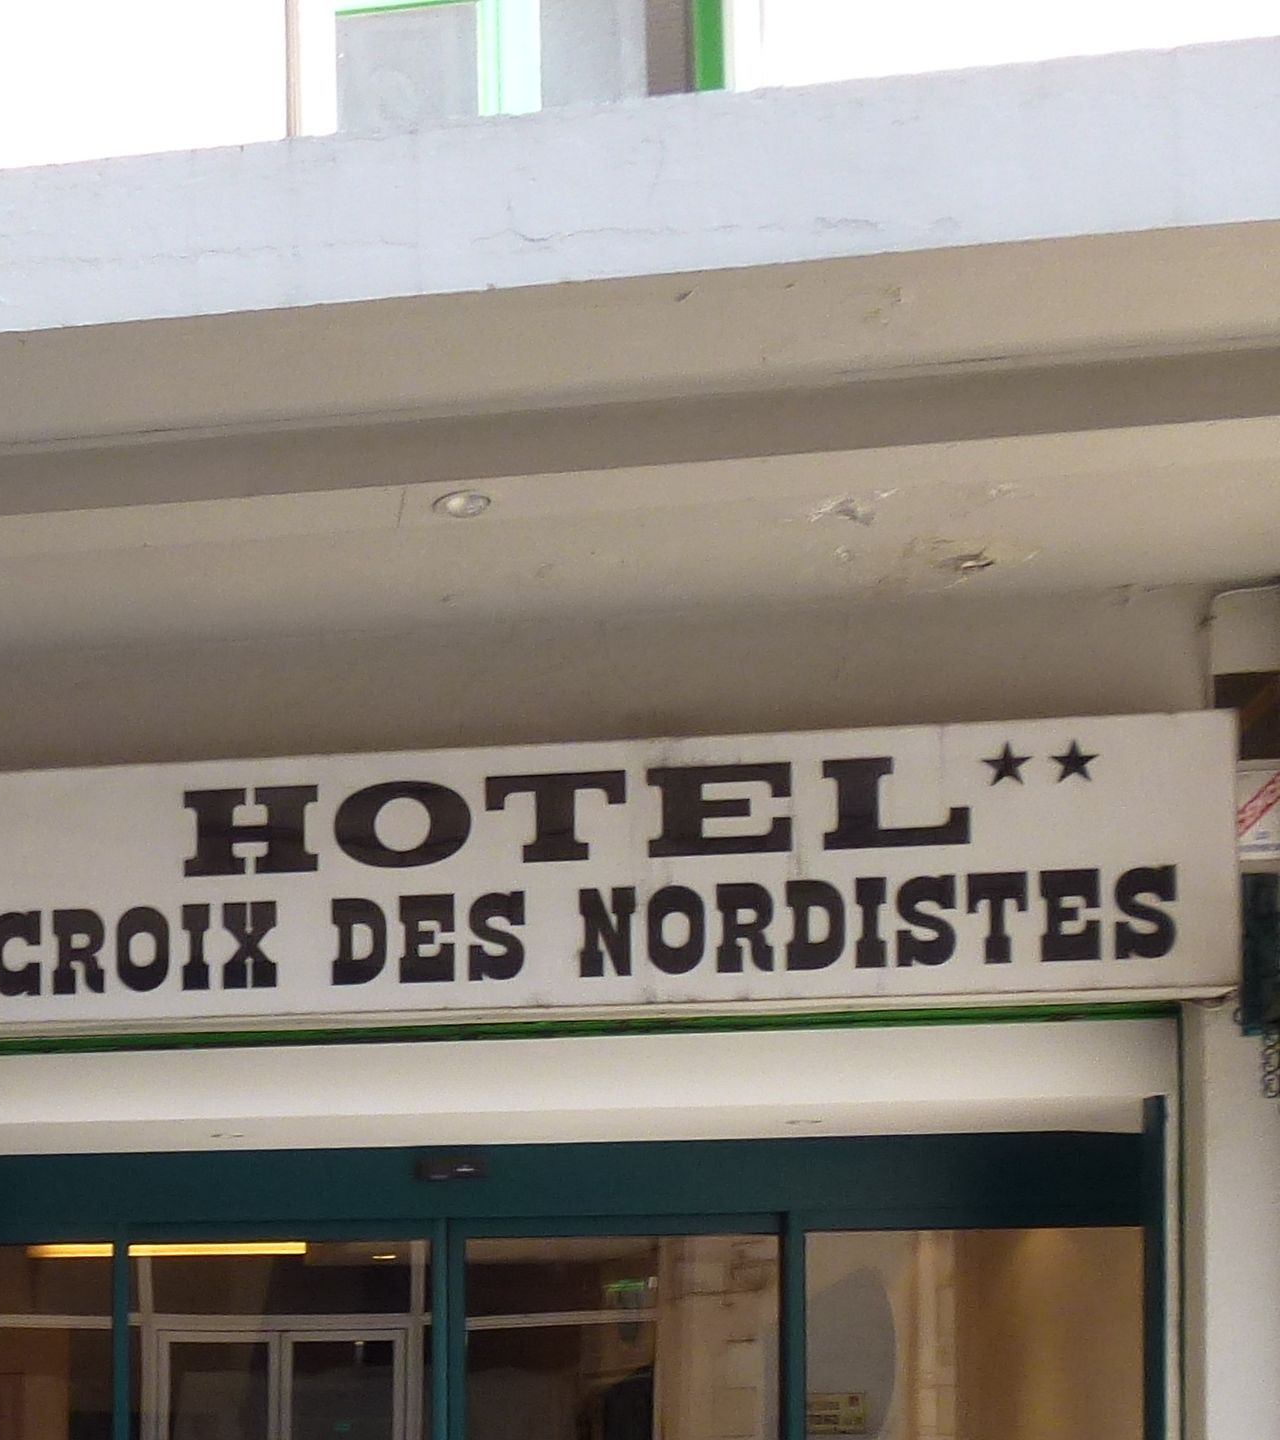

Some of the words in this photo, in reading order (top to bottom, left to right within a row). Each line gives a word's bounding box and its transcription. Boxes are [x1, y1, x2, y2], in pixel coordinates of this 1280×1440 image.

[182, 757, 971, 877] HOTEL
[331, 890, 527, 986] DES
[577, 864, 1180, 978] NORDISTES
